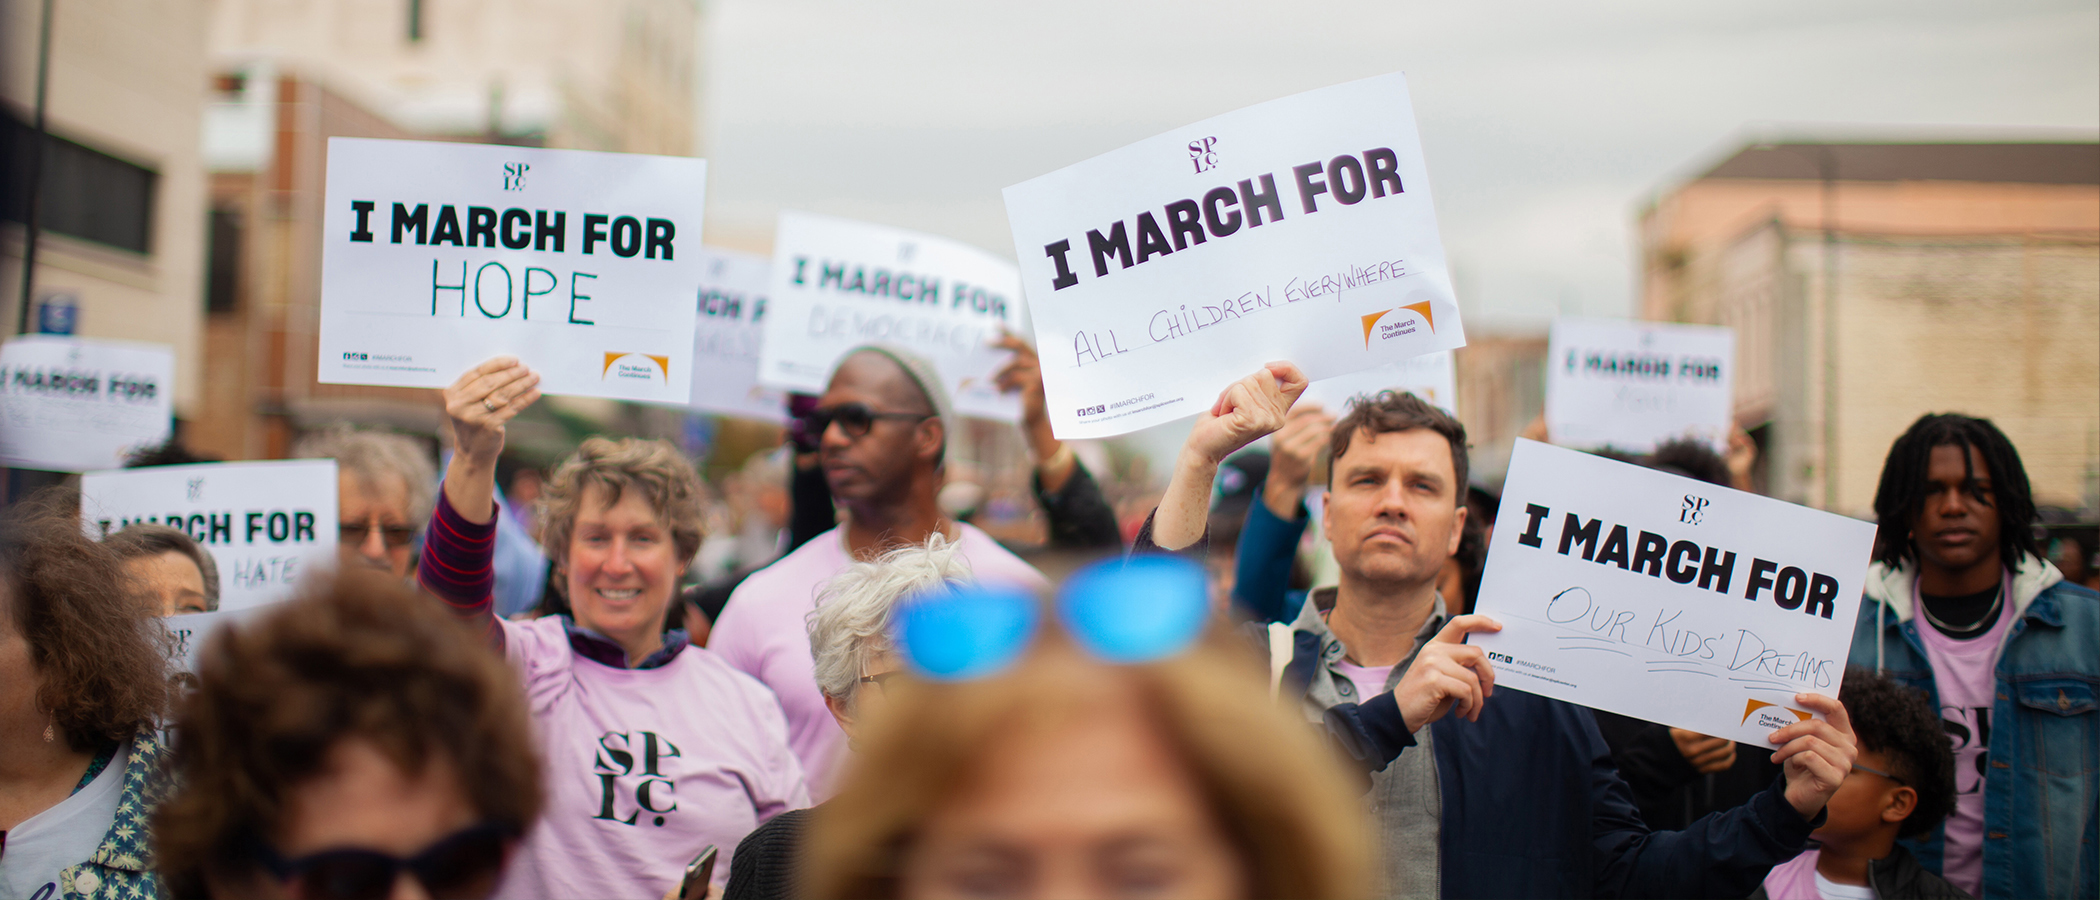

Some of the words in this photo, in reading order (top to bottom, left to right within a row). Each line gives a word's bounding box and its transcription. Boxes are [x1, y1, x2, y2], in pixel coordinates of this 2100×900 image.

[350, 200, 375, 242] I
[390, 202, 566, 252] MARCH
[582, 212, 675, 261] FOR
[1044, 238, 1078, 291] I
[1086, 172, 1284, 278] MARCH
[1292, 147, 1405, 215] FOR
[431, 258, 598, 326] HOPE
[793, 255, 808, 285] I
[820, 260, 941, 305] MARCH
[951, 281, 1008, 319] FOR
[1074, 330, 1127, 367] ALL
[1148, 284, 1271, 344] CHILDREN
[1284, 259, 1406, 303] EVERYWHERE
[1380, 324, 1393, 332] The
[1393, 319, 1415, 330] March
[1381, 327, 1416, 340] Continues
[245, 511, 316, 544] FOR
[233, 556, 298, 588] HATE
[1517, 502, 1550, 549] I
[1557, 512, 1737, 595] MARCH
[1745, 557, 1840, 620] FOR
[1546, 586, 1635, 644] OUR
[1726, 629, 1834, 688] DREAMS
[1760, 713, 1772, 721] The
